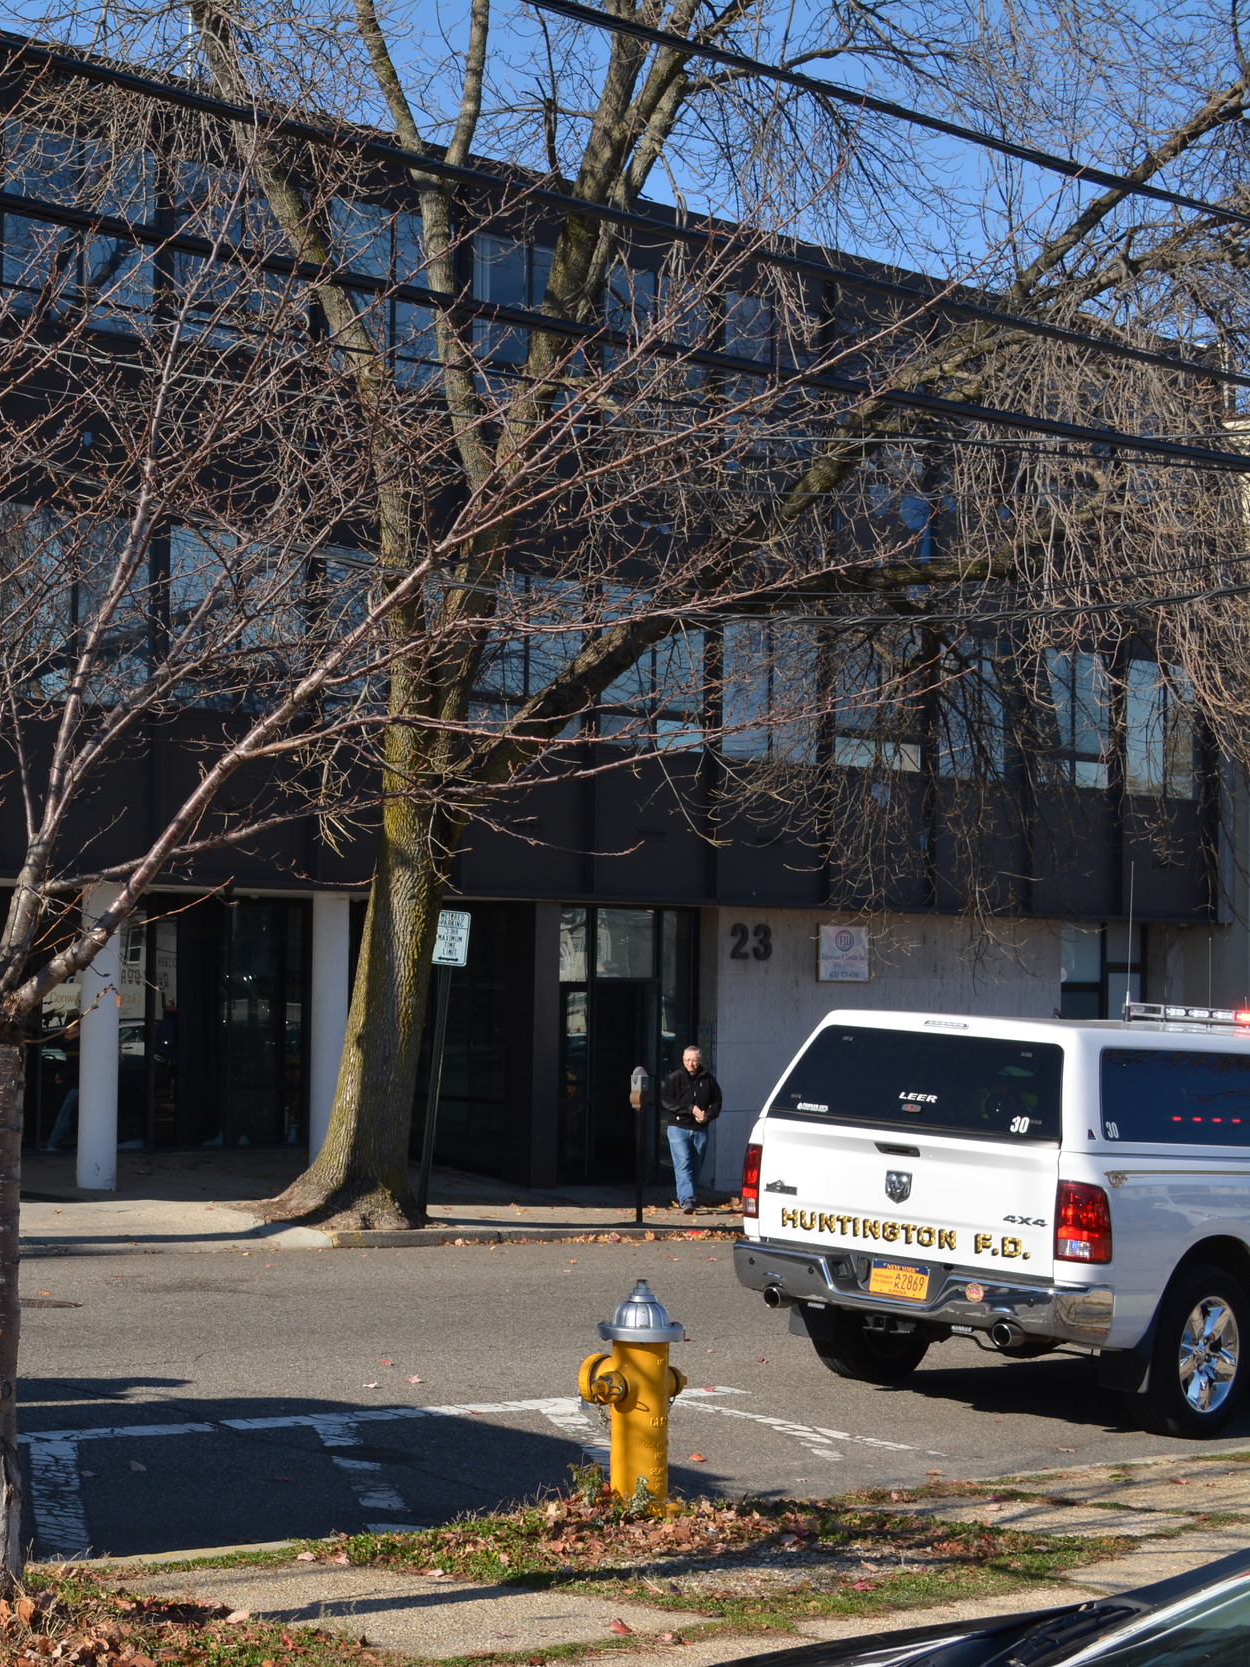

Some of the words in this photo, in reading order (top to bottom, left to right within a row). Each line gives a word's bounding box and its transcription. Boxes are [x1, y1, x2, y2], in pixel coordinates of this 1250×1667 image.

[730, 923, 772, 961] 23
[898, 1091, 938, 1103] LEER
[1010, 1116, 1030, 1134] 30
[1105, 1121, 1120, 1139] 30
[781, 1207, 957, 1250] HUNTINGTON
[974, 1233, 1031, 1260] F.D.
